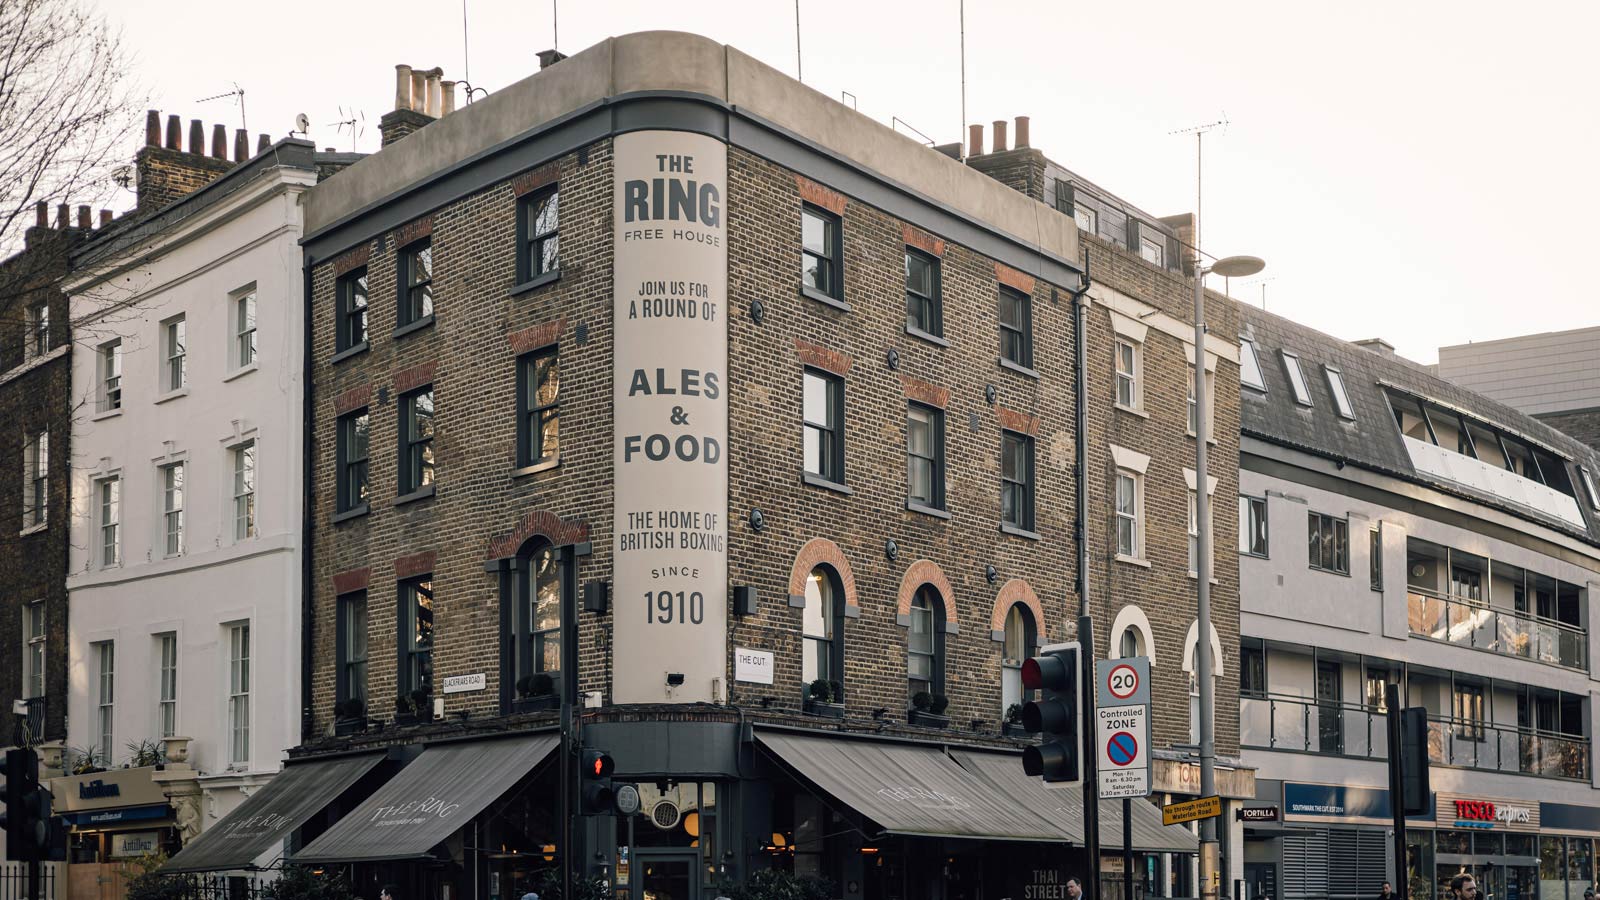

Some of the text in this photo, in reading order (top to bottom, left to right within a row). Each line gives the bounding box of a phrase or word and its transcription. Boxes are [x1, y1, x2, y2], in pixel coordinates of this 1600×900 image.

[656, 154, 693, 174] THE
[624, 178, 720, 228] RING
[625, 229, 720, 247] FREE HOUSE
[638, 281, 708, 298] JOIN US FOR
[628, 299, 716, 322] A ROUND OF
[628, 368, 720, 400] ALES
[670, 406, 690, 425] &
[624, 434, 720, 464] FOOD
[628, 511, 718, 532] THE HOME OF
[621, 532, 722, 553] BRITISH BOXING
[651, 566, 700, 579] SINCE
[644, 590, 704, 624] 1910
[739, 655, 766, 666] THE CUT
[444, 676, 480, 688] BLACKFRIARS ROAD
[1113, 674, 1134, 688] 20
[1100, 709, 1142, 718] Controlled
[1106, 719, 1136, 730] ZONE
[371, 796, 459, 821] THE RING
[1172, 812, 1196, 820] Waterloo
[1174, 804, 1196, 812] through
[1455, 800, 1530, 828] TESCO express
[258, 814, 292, 830] RING
[122, 838, 152, 851] Antillean
[1033, 870, 1058, 884] THAI
[1025, 885, 1066, 899] STREET
